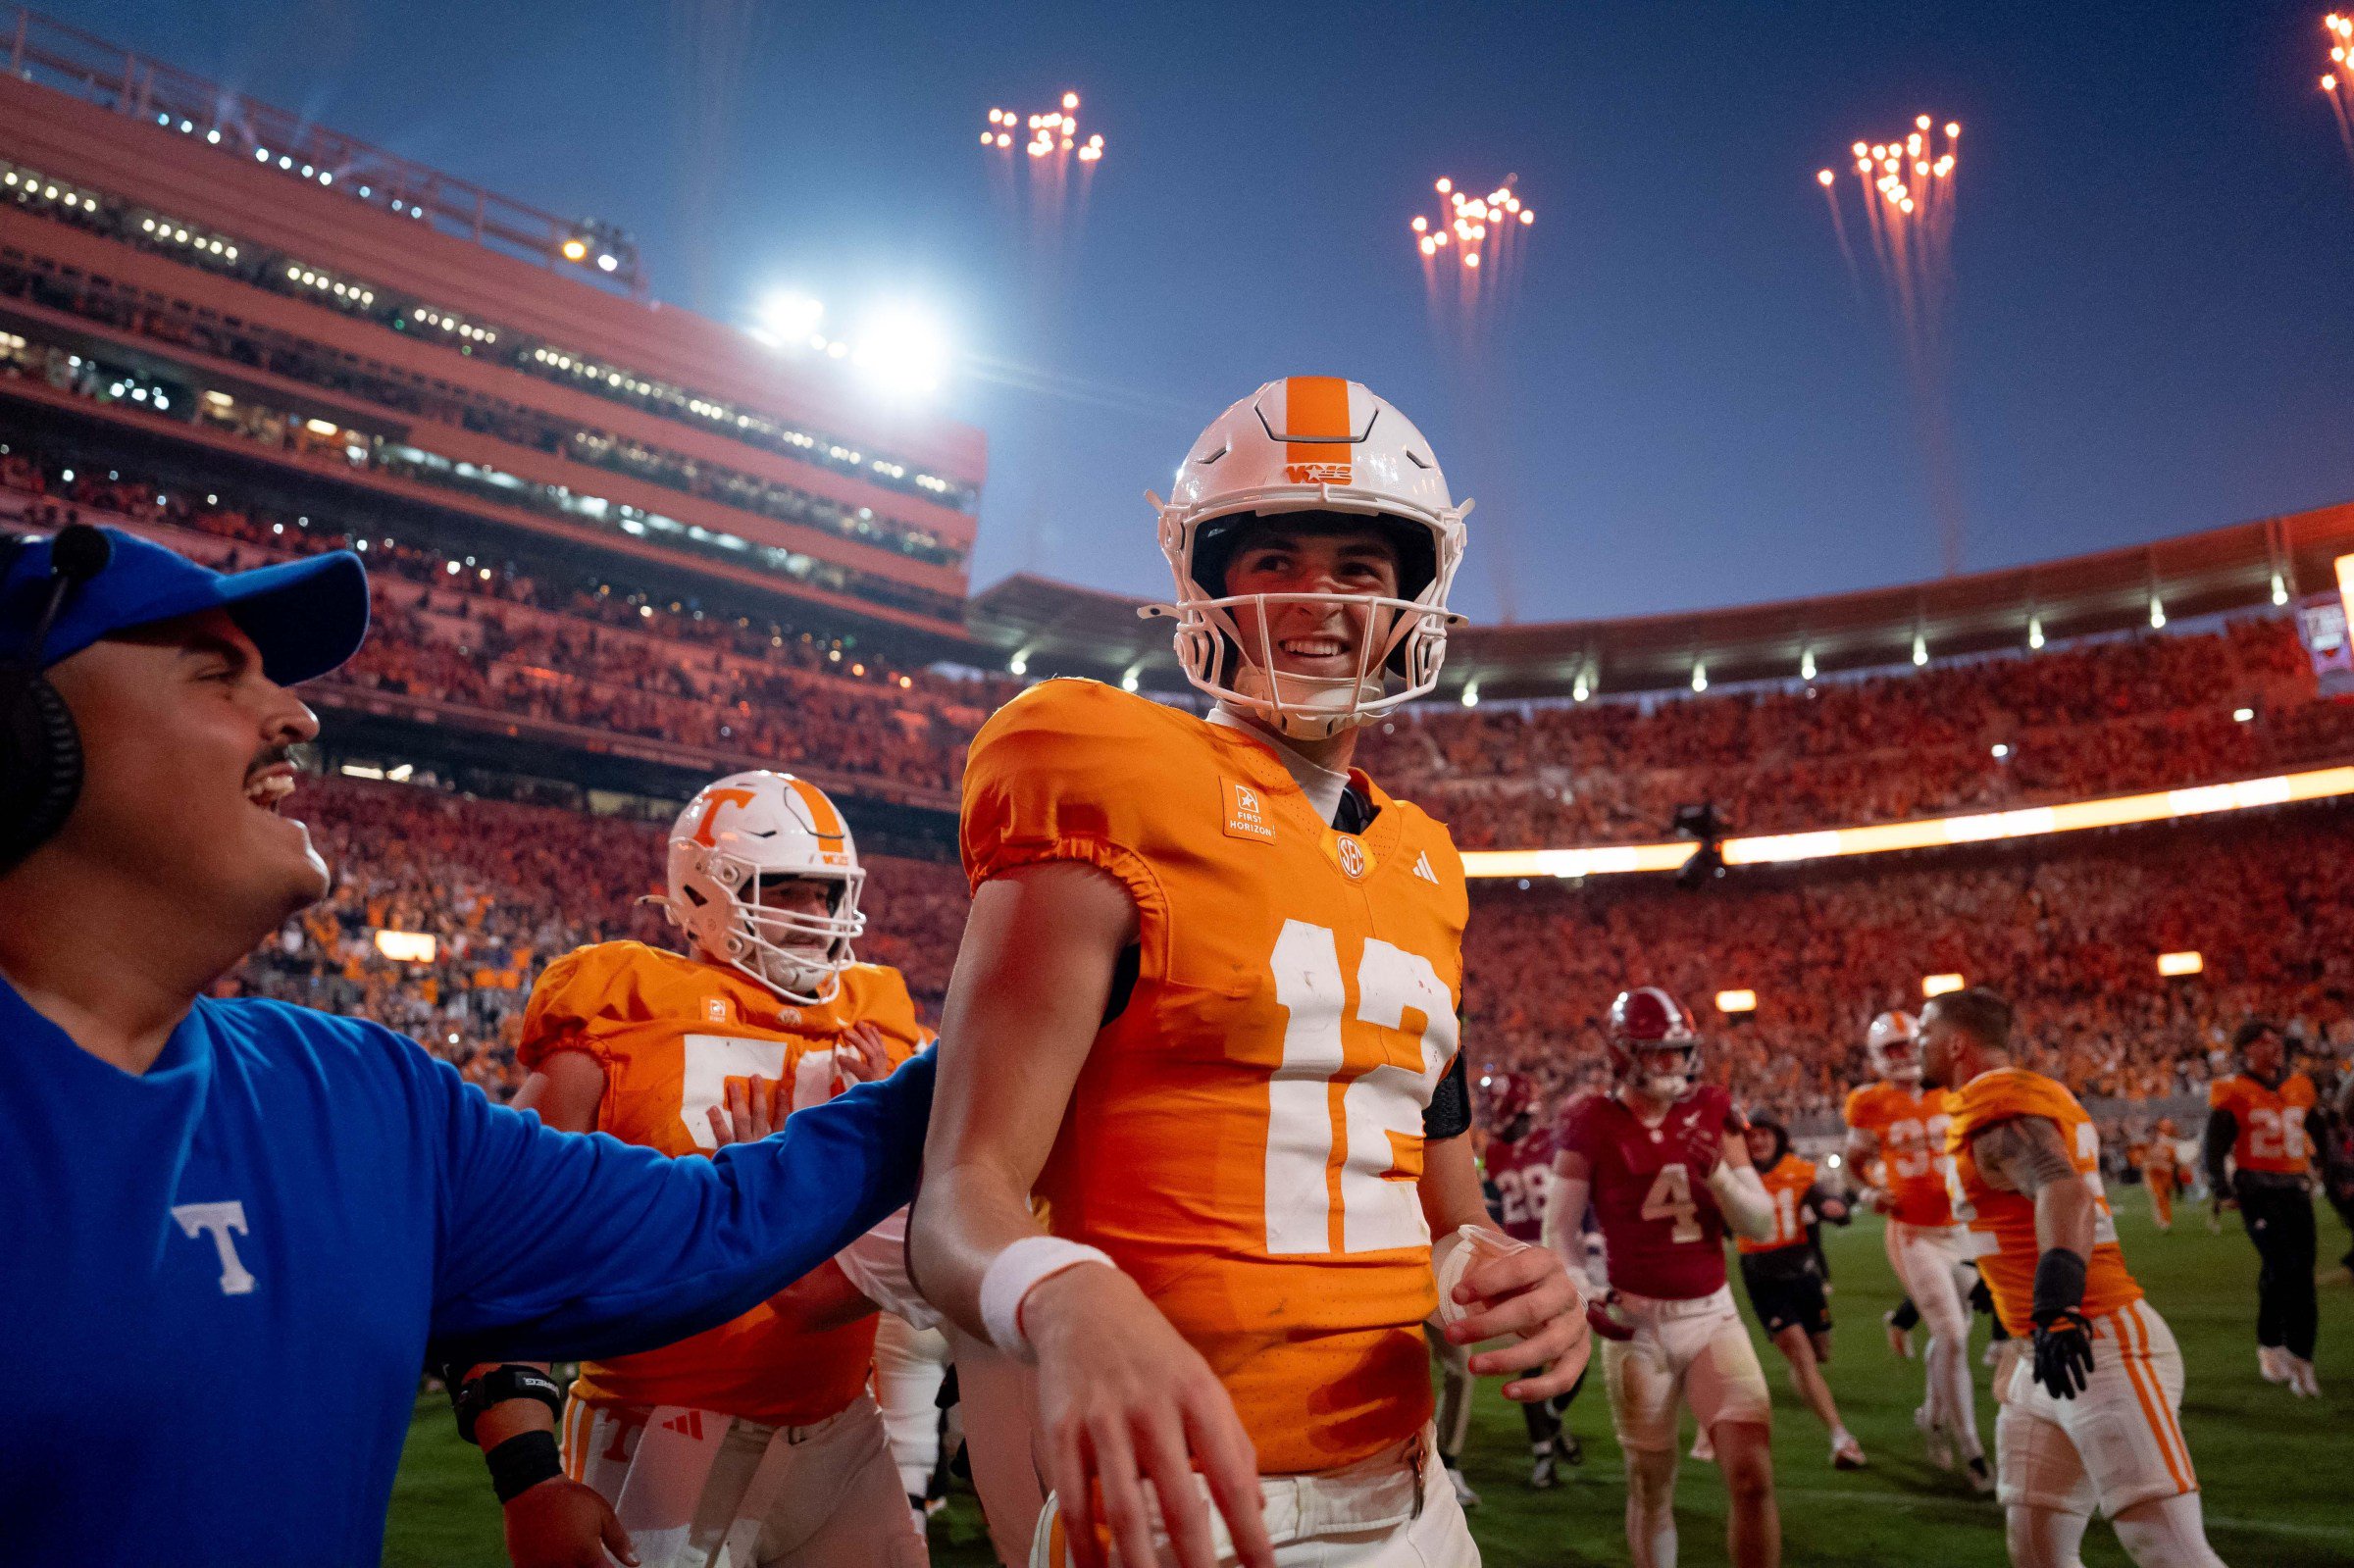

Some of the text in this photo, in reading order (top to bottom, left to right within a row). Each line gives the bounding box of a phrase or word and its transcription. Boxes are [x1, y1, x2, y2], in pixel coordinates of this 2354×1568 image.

[692, 788, 757, 847] T
[1230, 820, 1272, 837] HORIZON
[1237, 811, 1262, 824] FIRST
[1340, 837, 1364, 875] SEC
[1265, 918, 1458, 1254] 12
[1640, 1163, 1704, 1243] 4
[171, 1200, 256, 1294] T
